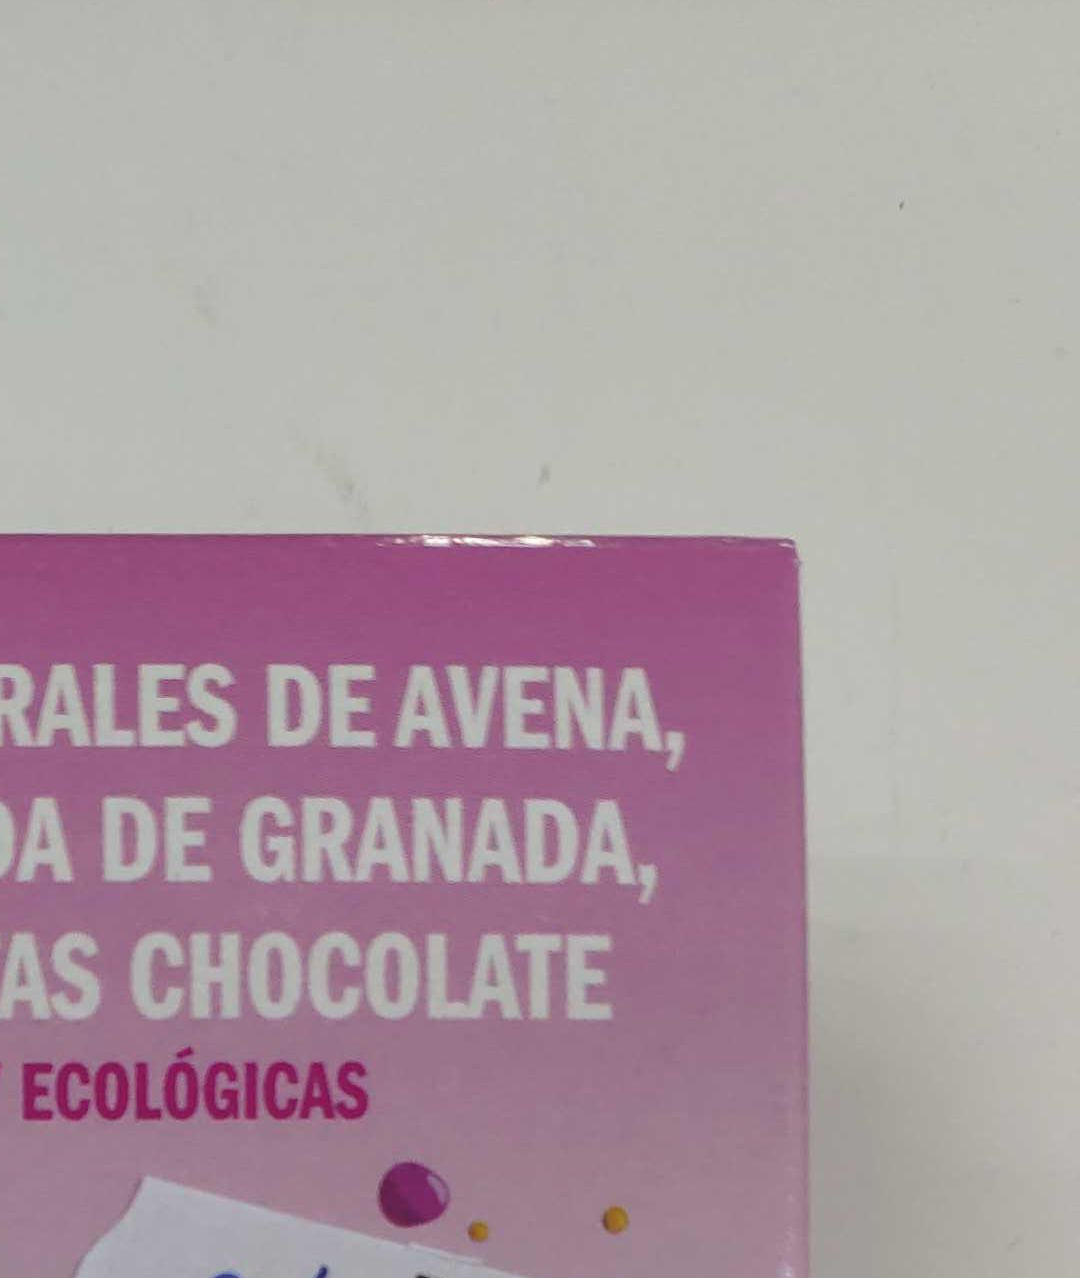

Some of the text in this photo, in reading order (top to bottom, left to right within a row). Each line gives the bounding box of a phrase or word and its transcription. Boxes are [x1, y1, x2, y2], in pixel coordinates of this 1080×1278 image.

[266, 663, 377, 748] DE
[394, 664, 686, 771] AVENA,
[101, 796, 213, 883] DE
[239, 796, 659, 904] GRANADA,
[129, 931, 614, 1022] CHOCOLATE
[21, 1047, 370, 1123] ECOLÓGICAS
